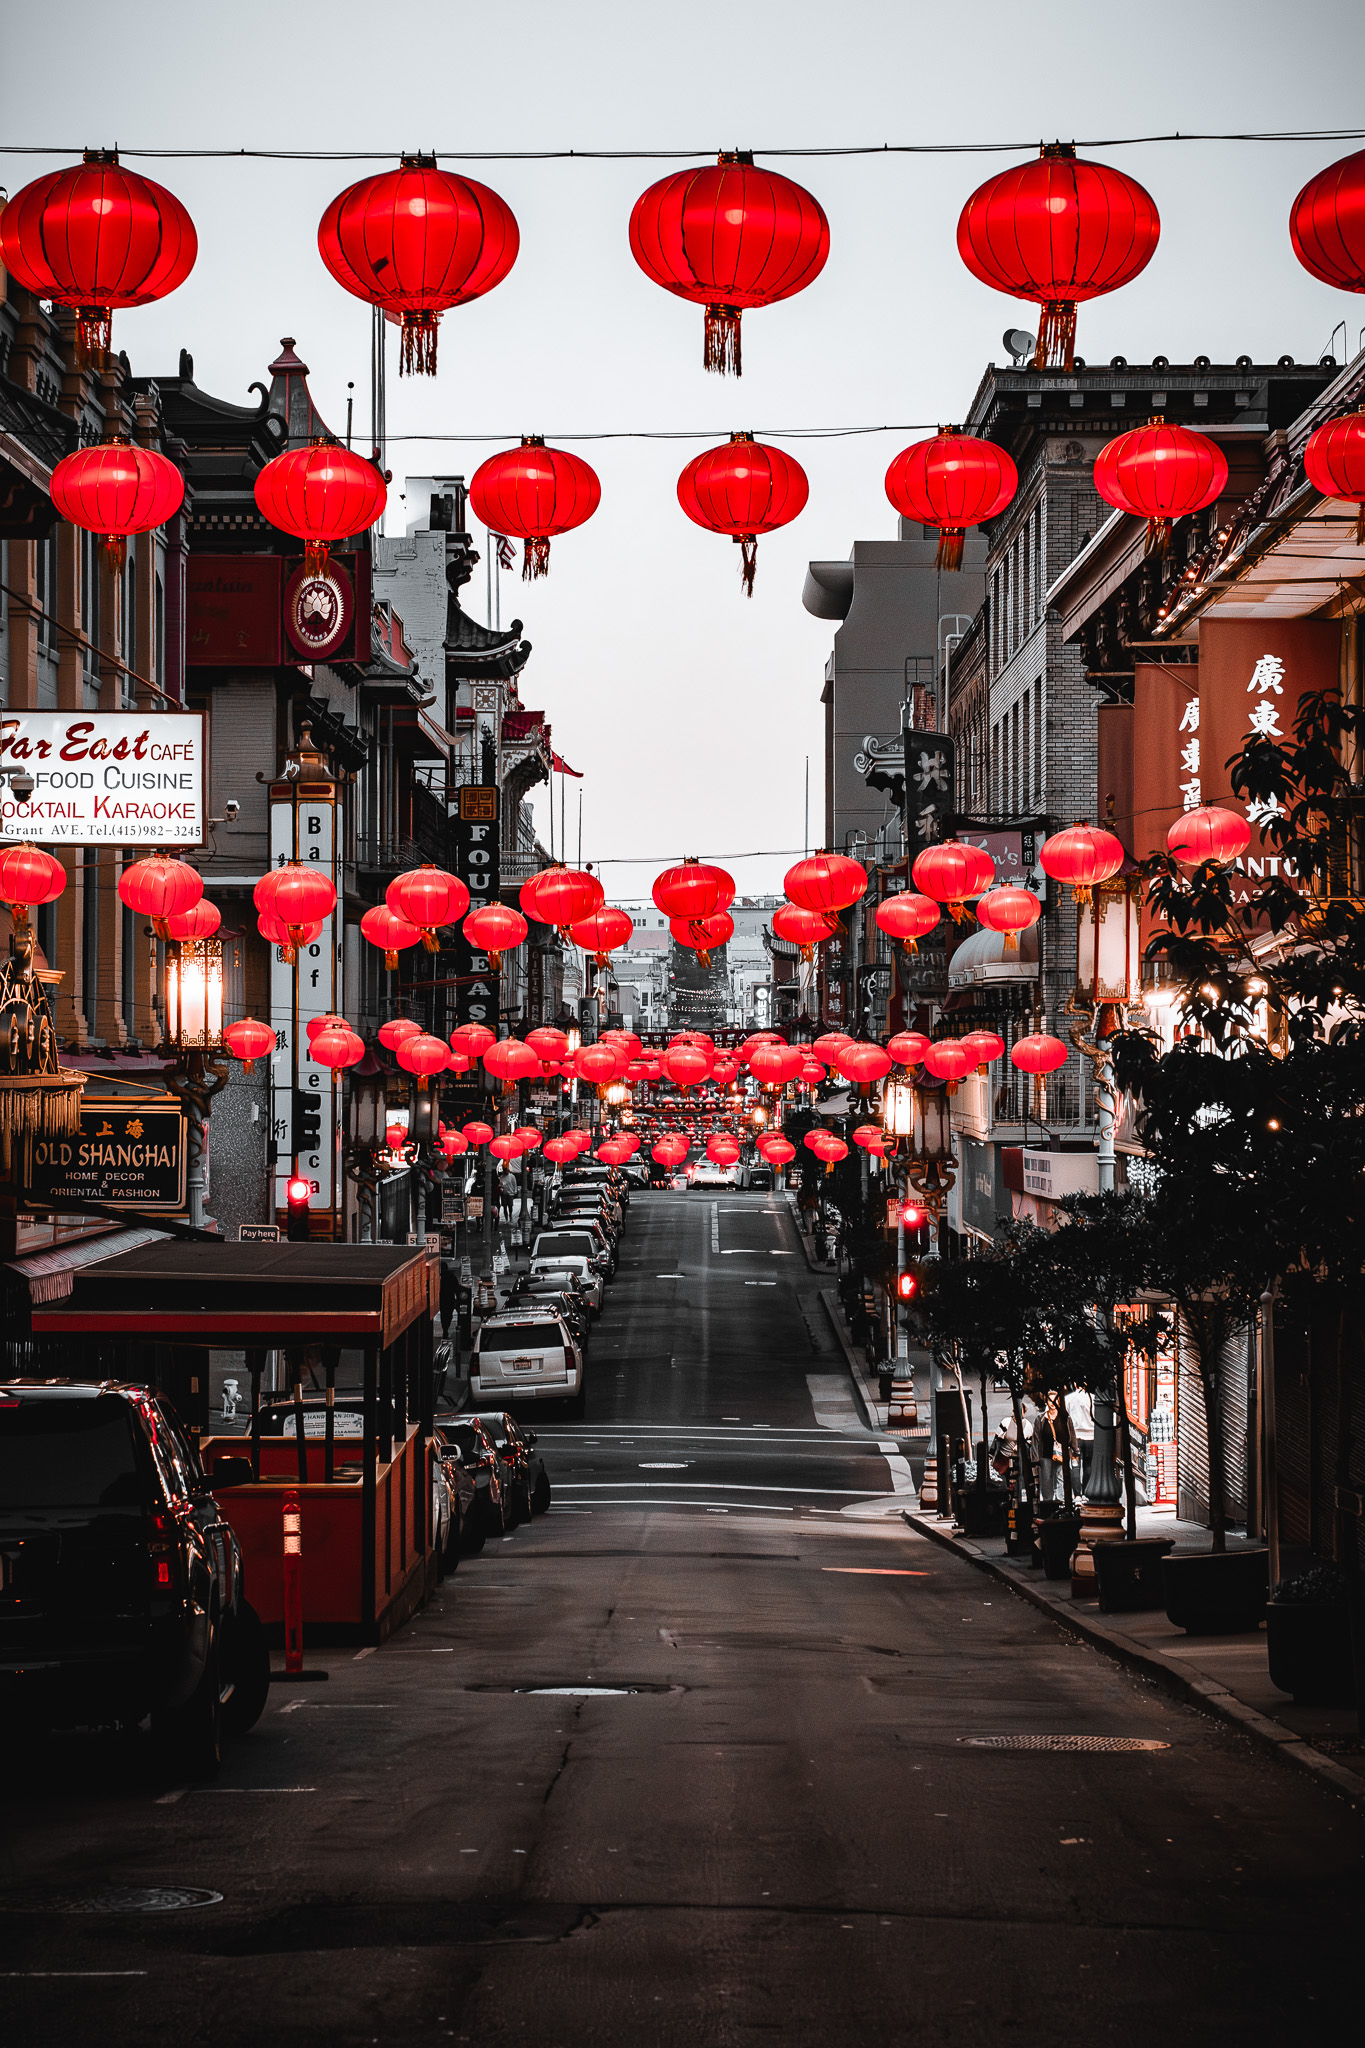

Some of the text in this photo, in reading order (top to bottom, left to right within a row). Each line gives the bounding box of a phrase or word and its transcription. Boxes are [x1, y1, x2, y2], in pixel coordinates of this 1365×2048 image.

[60, 722, 150, 761] East
[151, 740, 194, 761] CAFÉ
[0, 772, 94, 789] FOOD
[0, 801, 85, 820] OCKTAIL
[5, 824, 43, 836] Grant
[51, 825, 84, 836] AVE.
[467, 945, 493, 1020] EAS
[757, 1000, 767, 1029] HASE
[35, 1142, 176, 1168] OLD SHANGHAI
[65, 1171, 145, 1182] HOME DECOR
[101, 1180, 108, 1188] &
[50, 1187, 160, 1198] ORIENTAL FASHION
[242, 1230, 276, 1239] Pay here
[409, 1236, 438, 1245] SED
